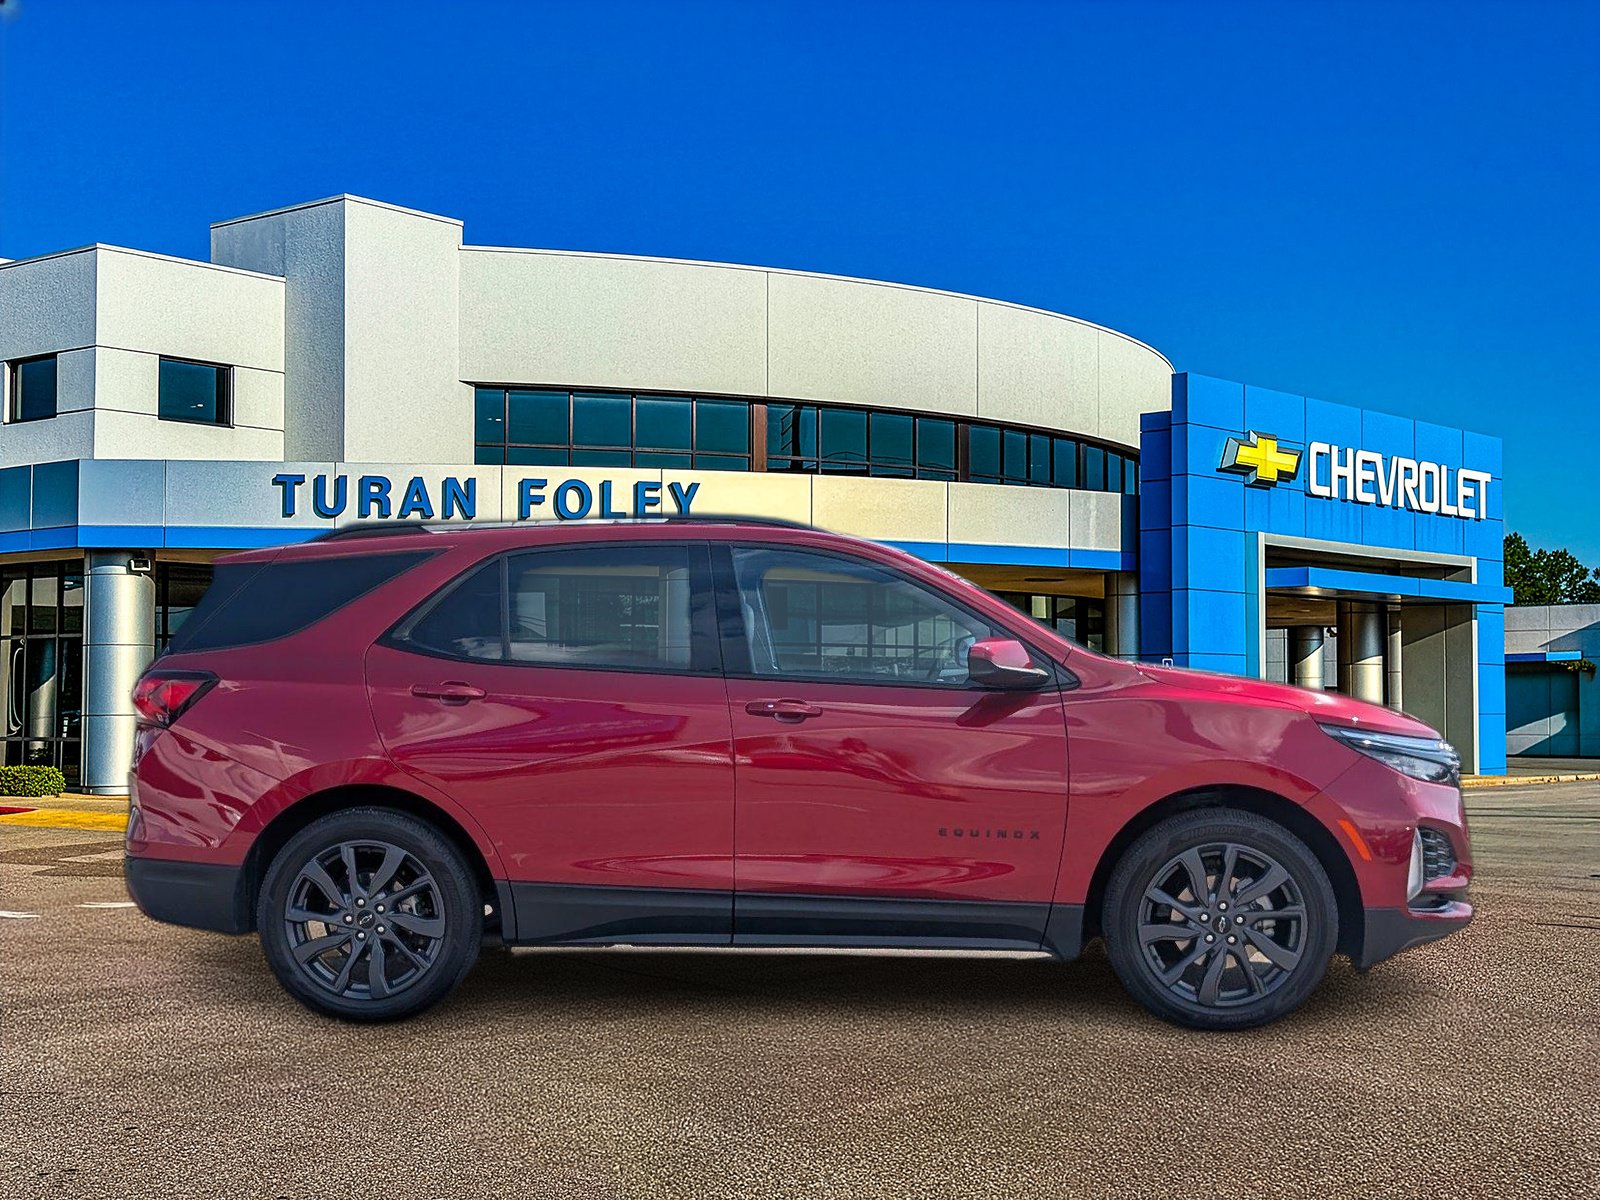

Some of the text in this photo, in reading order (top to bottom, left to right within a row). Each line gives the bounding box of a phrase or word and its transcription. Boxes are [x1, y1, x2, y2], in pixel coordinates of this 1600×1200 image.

[272, 474, 701, 521] TURAN FOLEY
[1307, 441, 1492, 521] CHEVROLET
[938, 827, 1040, 840] EQUINOX
